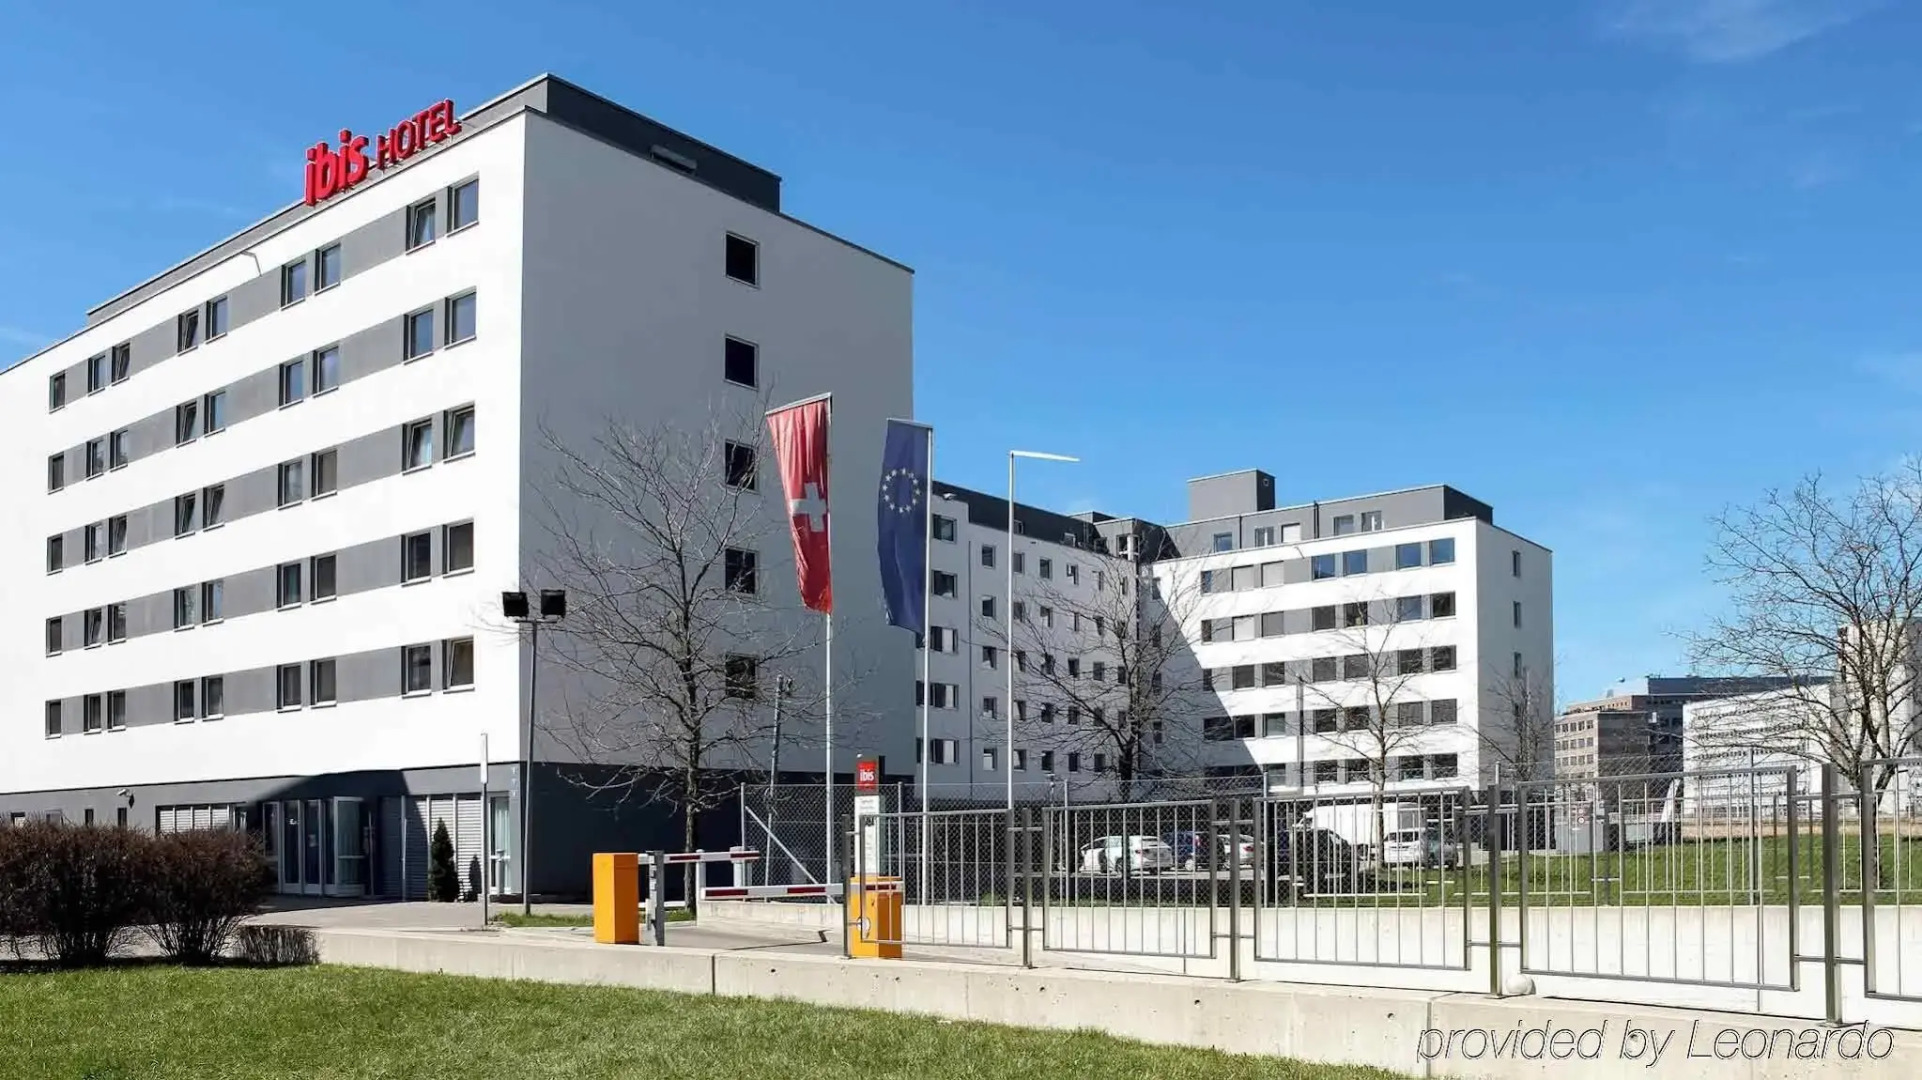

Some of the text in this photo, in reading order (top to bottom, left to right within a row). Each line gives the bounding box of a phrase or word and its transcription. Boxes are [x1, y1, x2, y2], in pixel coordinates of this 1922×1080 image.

[305, 98, 462, 206] ibis HOTEL
[859, 768, 875, 782] ibis
